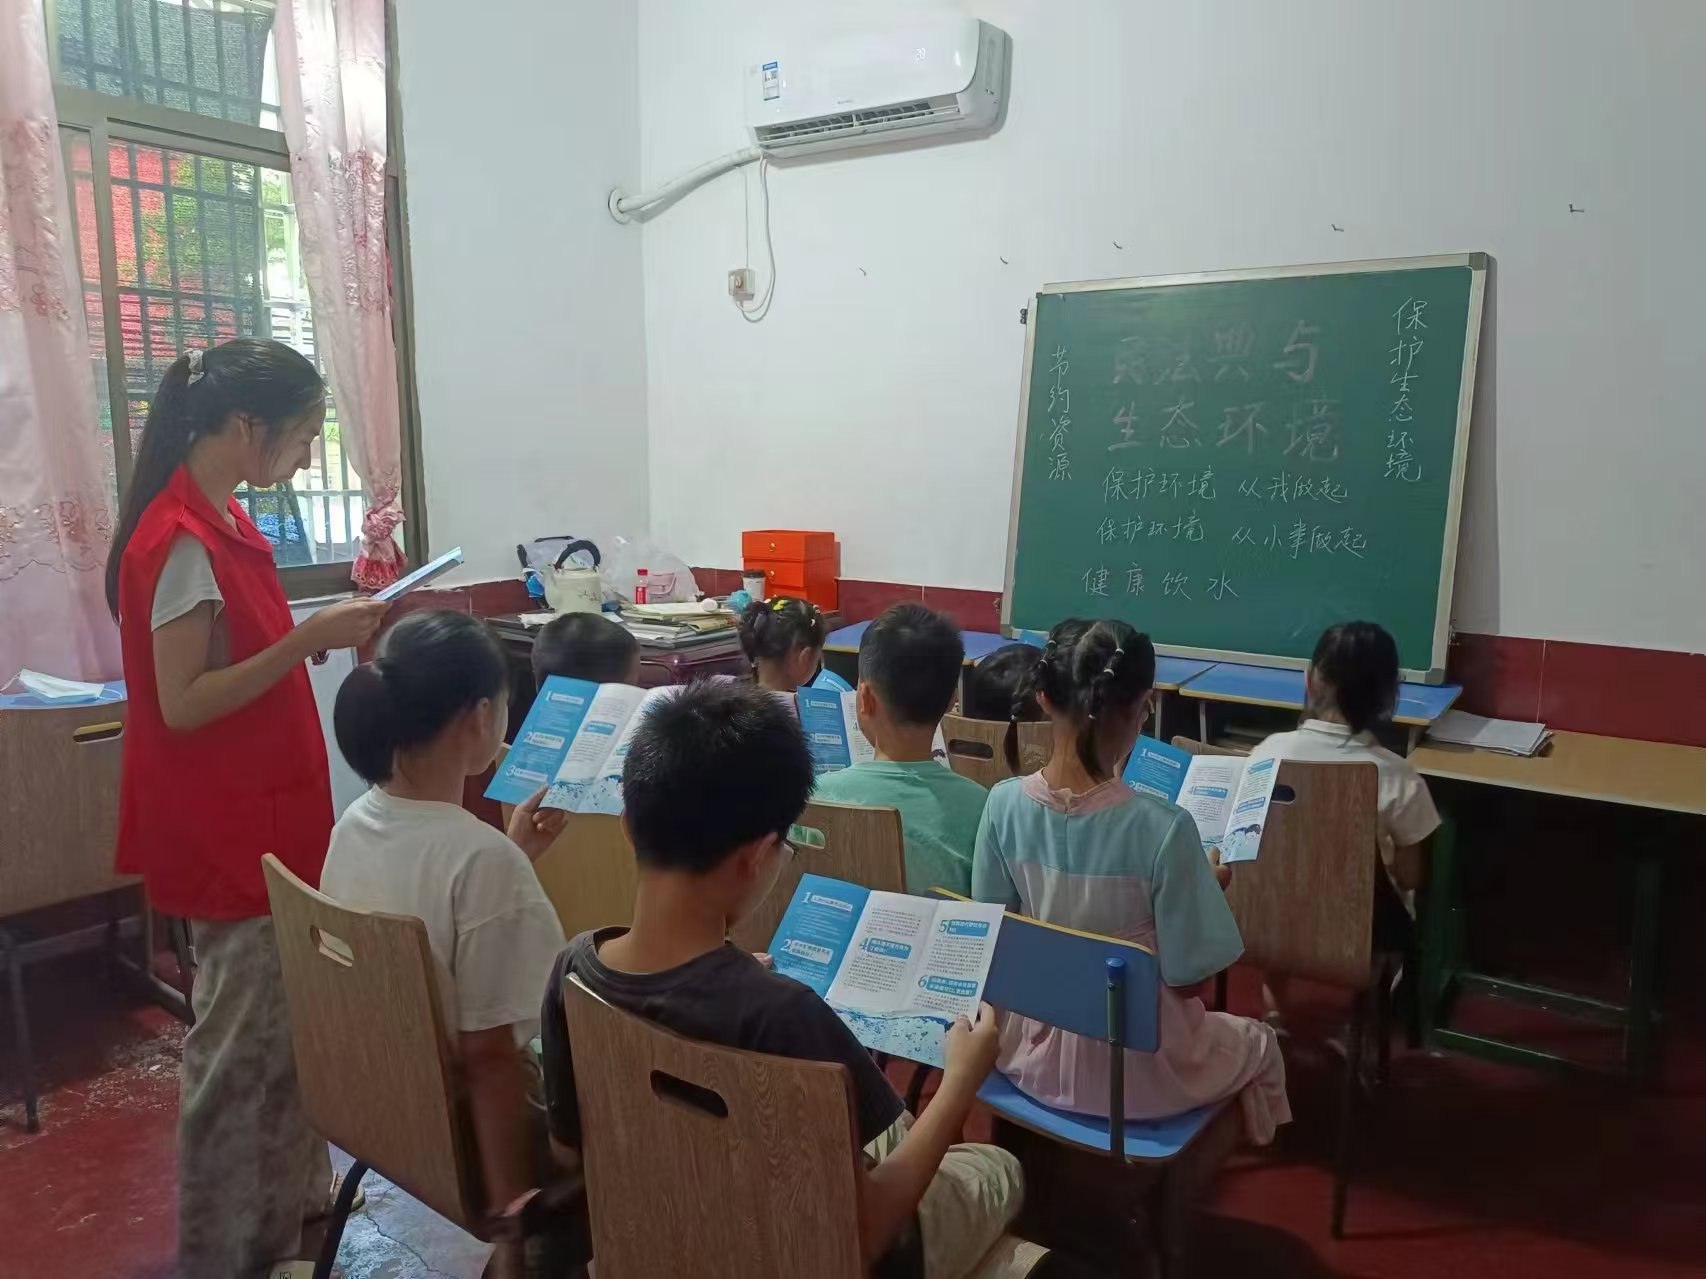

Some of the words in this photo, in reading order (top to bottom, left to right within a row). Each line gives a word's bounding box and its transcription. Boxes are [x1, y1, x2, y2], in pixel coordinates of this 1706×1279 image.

[1047, 345, 1073, 481] 节约资源
[1384, 297, 1428, 482] 保护生态环境
[1107, 397, 1340, 462] 生态环境
[1102, 465, 1217, 502] 保护环境
[1237, 470, 1350, 504] 从我做起
[1096, 511, 1205, 545] 保护环境
[1231, 517, 1368, 559] 从小事做起
[1081, 562, 1239, 599] 健康饮水
